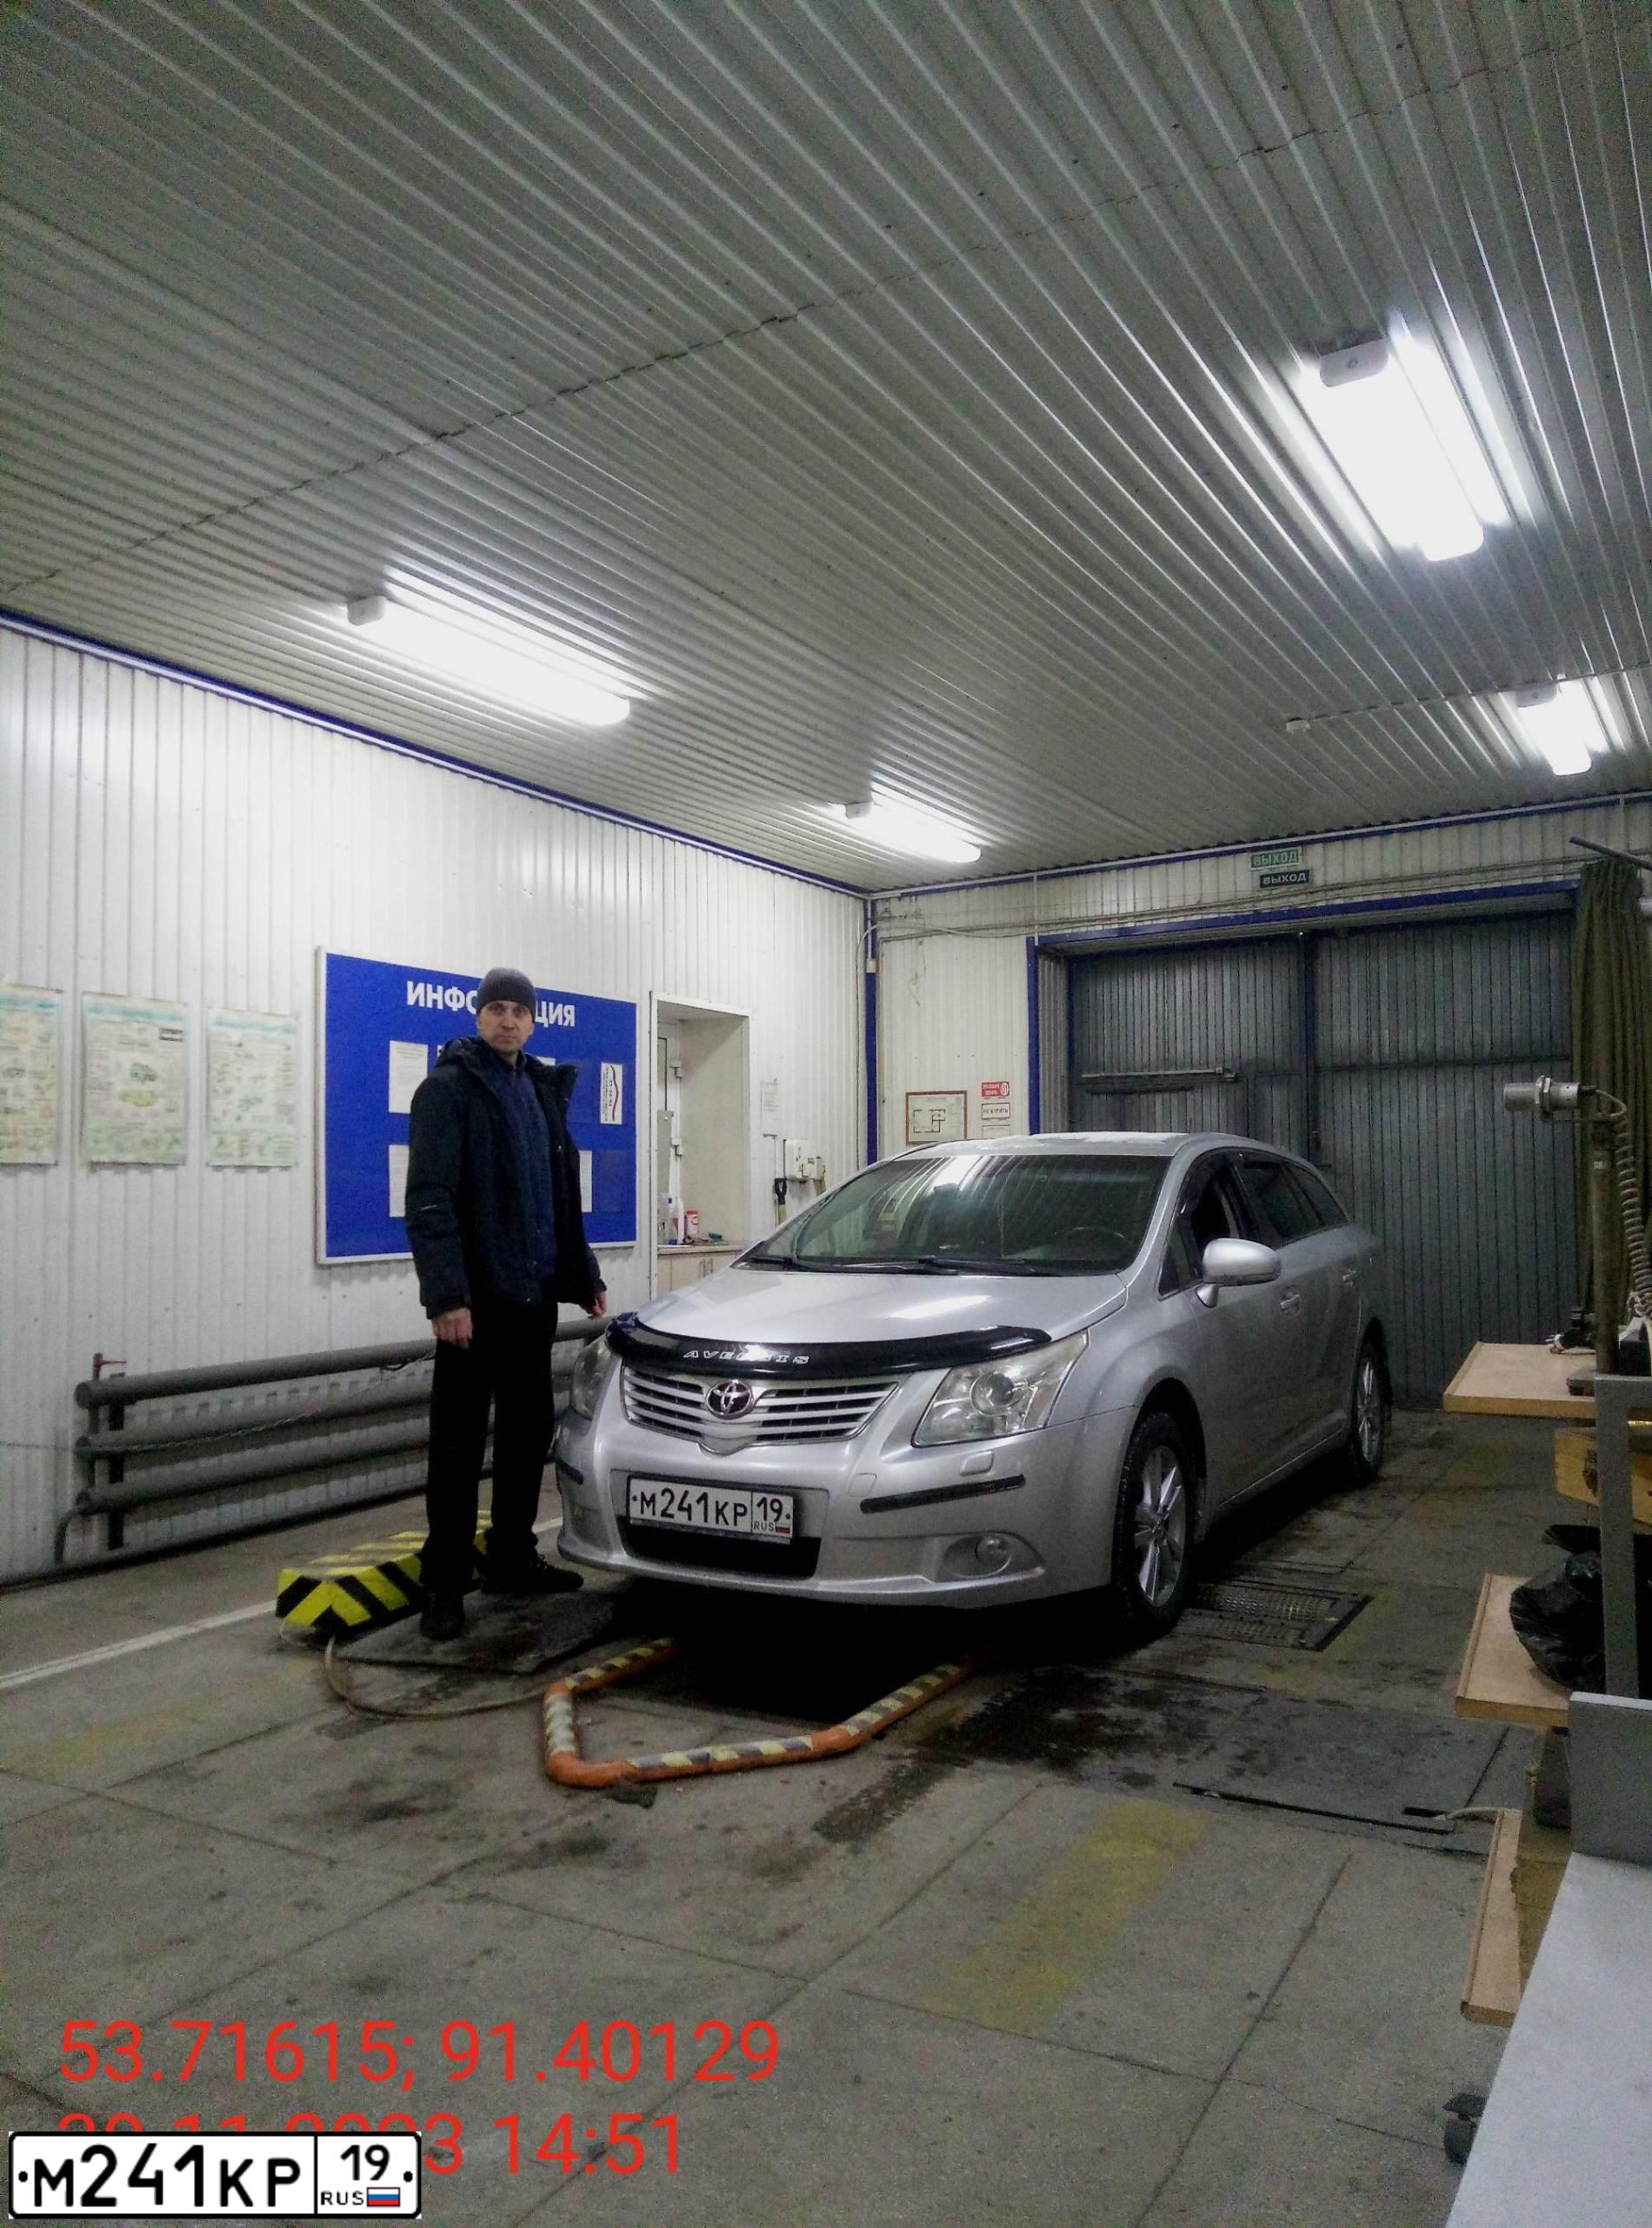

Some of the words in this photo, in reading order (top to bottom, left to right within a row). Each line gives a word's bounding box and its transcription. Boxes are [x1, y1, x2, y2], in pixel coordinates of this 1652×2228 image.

[1254, 851, 1297, 865] ВЫХОД
[1263, 872, 1307, 884] ВЫХОД
[406, 980, 576, 1028] ИНФОЦИЯ
[640, 1487, 748, 1526] М241КР
[756, 1497, 783, 1522] 19
[753, 1520, 775, 1531] RUS
